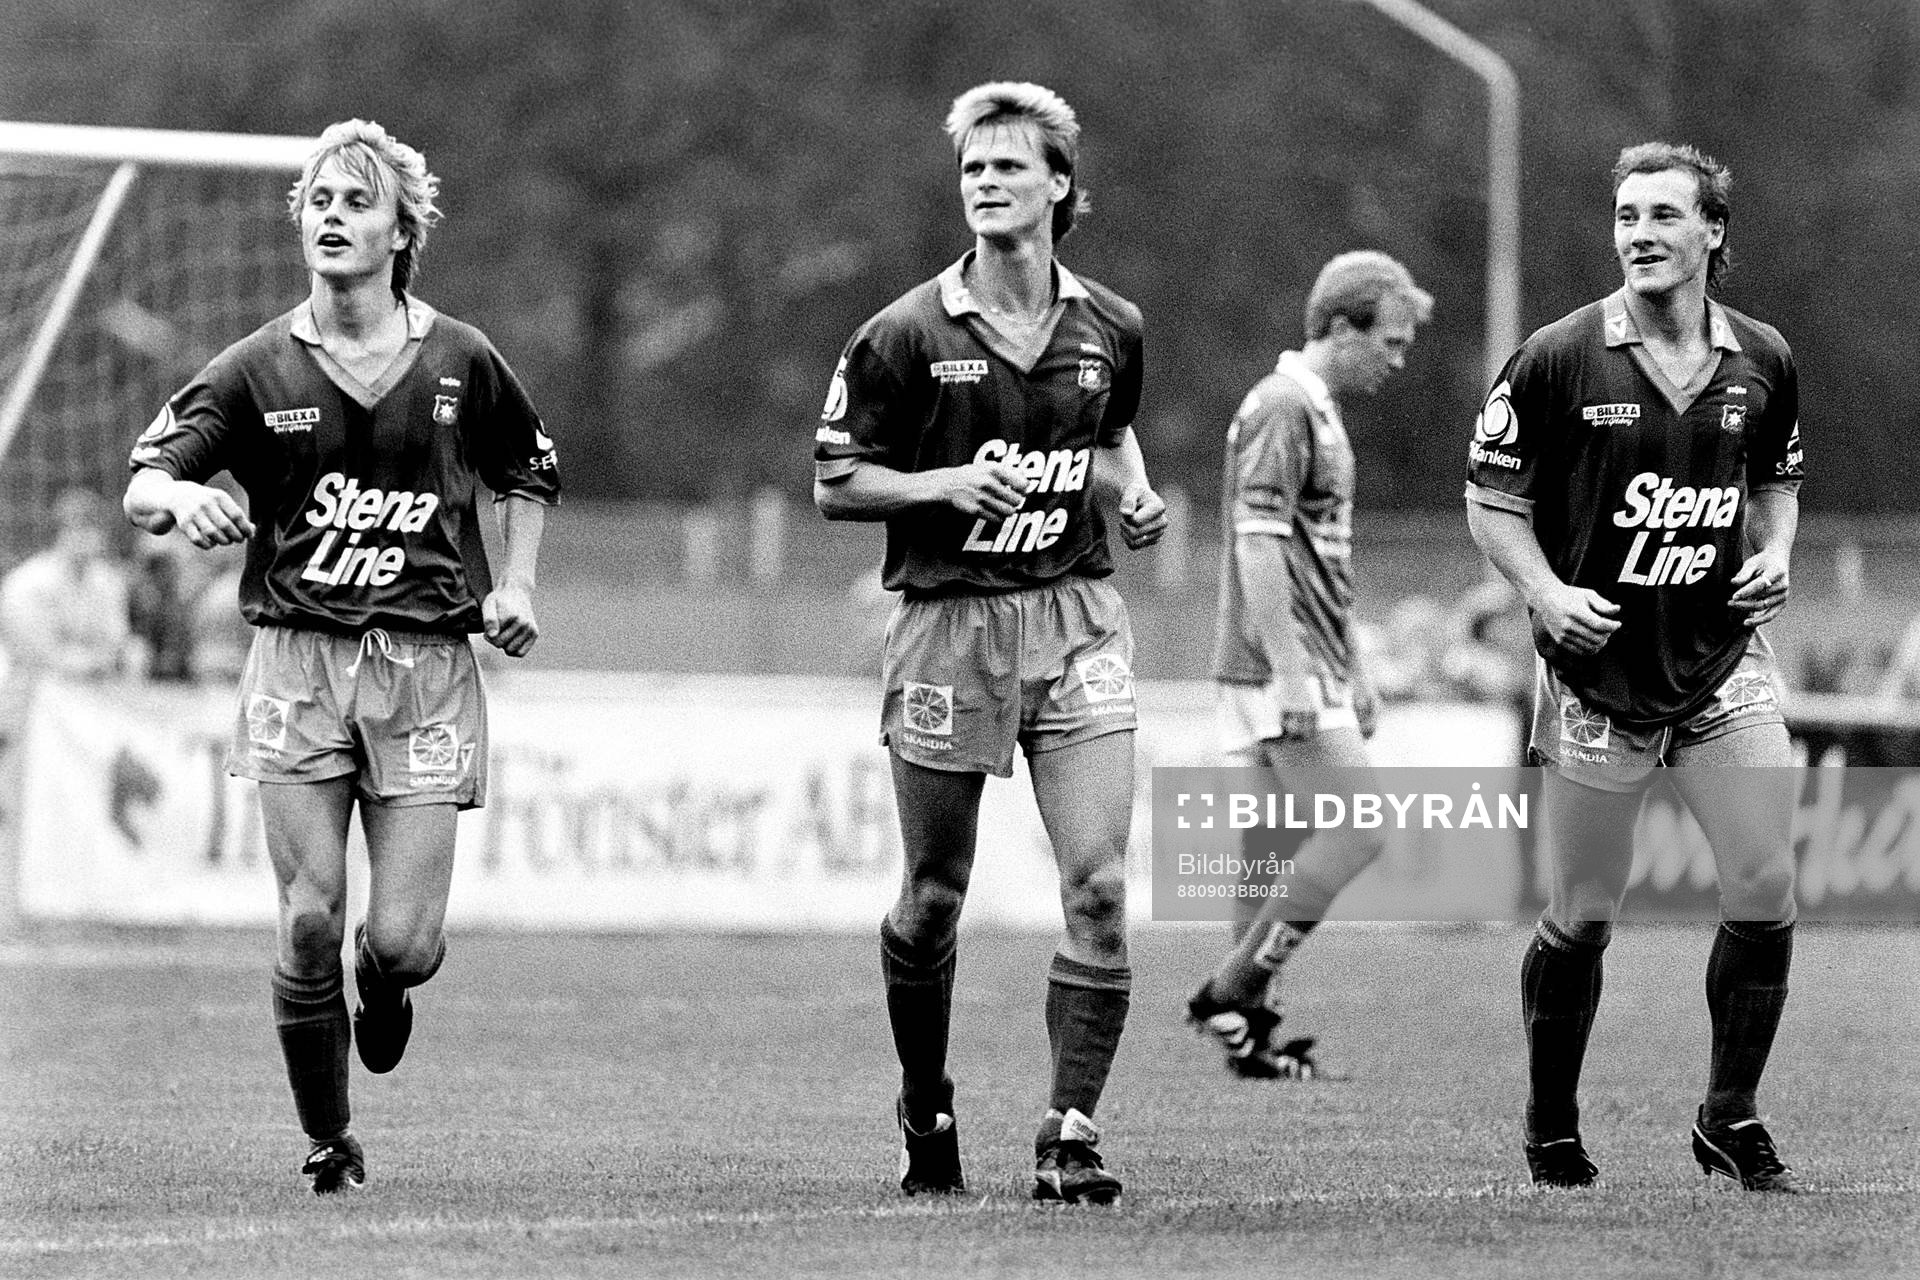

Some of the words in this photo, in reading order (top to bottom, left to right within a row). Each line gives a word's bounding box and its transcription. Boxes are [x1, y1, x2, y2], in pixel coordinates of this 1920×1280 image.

[943, 362, 984, 372] BILEXA
[276, 411, 317, 423] BILEXA
[1596, 406, 1638, 417] BILEXA
[305, 472, 440, 534] Stena
[1613, 471, 1740, 530] Stena
[962, 502, 1068, 553] Line
[301, 529, 406, 588] Line
[1617, 529, 1717, 587] Line
[409, 774, 458, 787] SKANDIA
